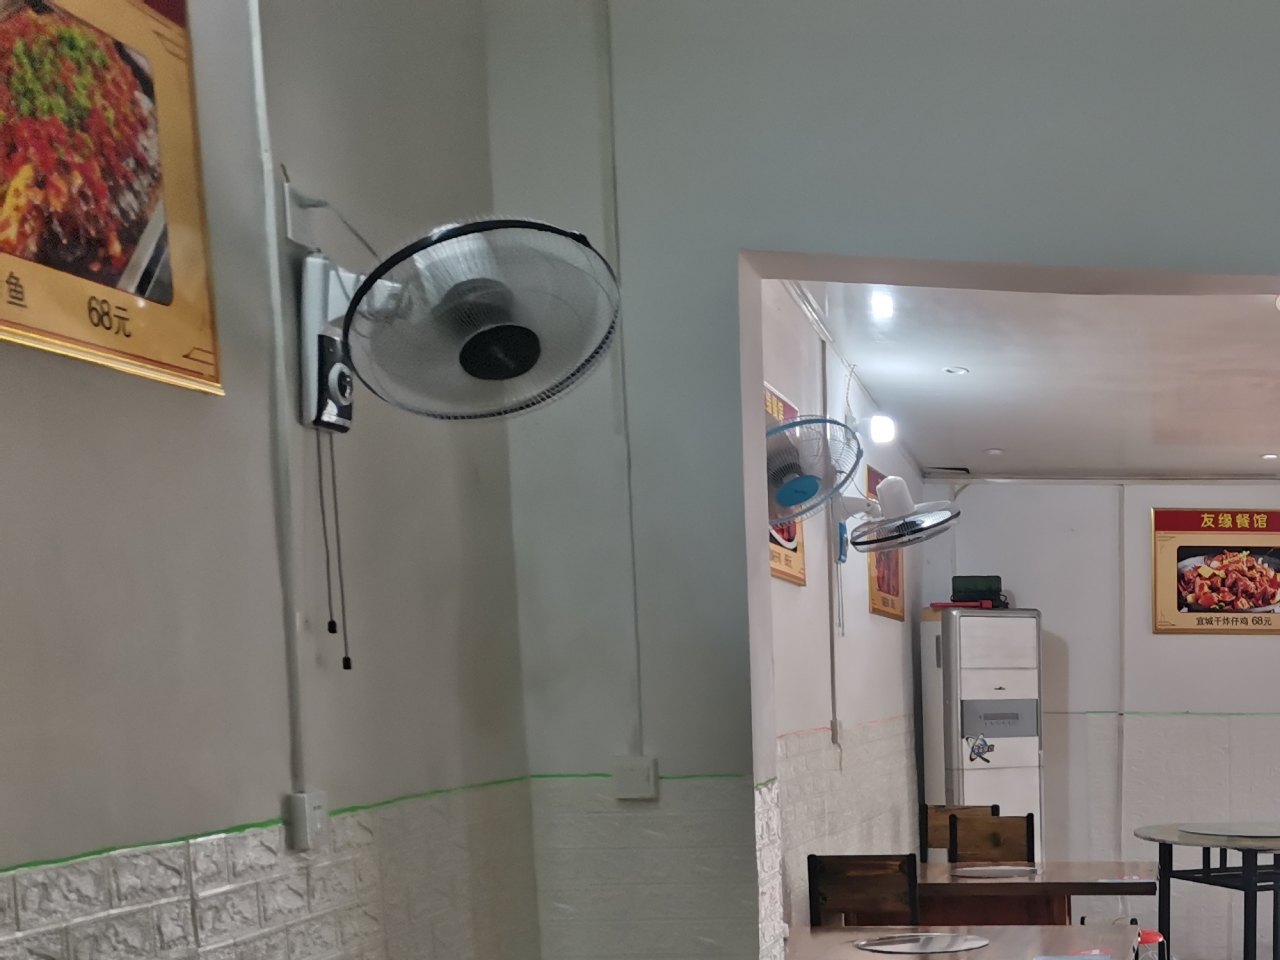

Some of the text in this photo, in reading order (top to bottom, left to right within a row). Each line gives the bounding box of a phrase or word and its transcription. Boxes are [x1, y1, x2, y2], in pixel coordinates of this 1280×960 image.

[6, 271, 132, 338] 鱼 68元
[1201, 513, 1268, 528] 友缘餐馆
[1196, 616, 1272, 626] 宜城干炸仔鸡 68元
